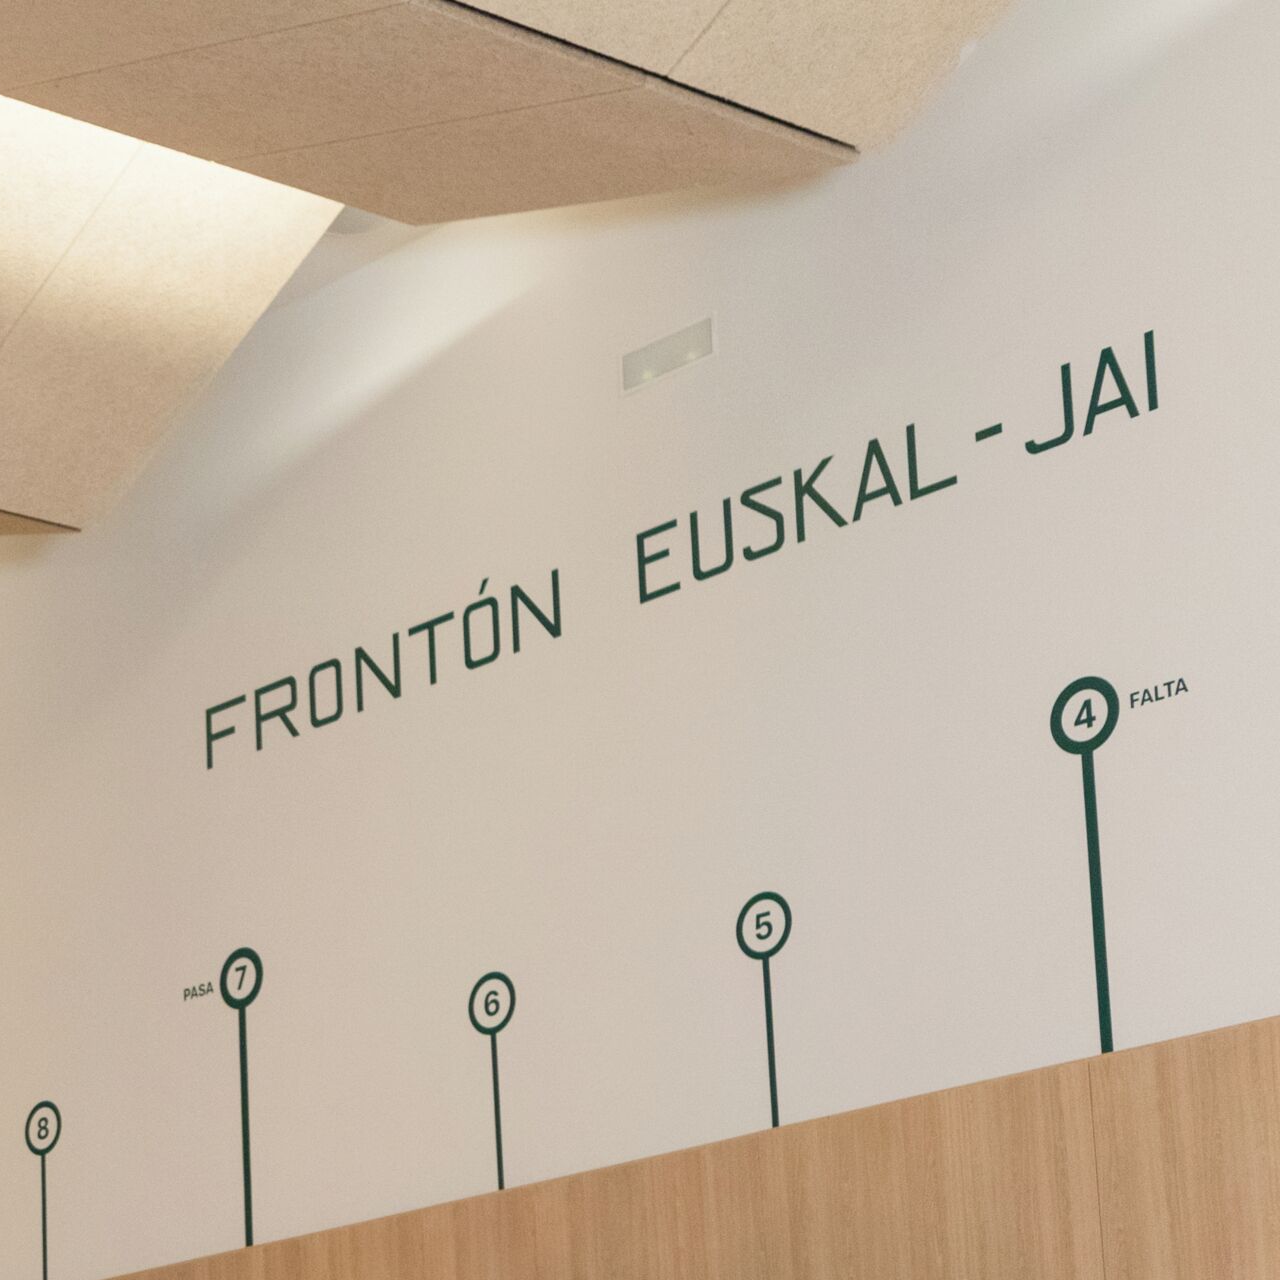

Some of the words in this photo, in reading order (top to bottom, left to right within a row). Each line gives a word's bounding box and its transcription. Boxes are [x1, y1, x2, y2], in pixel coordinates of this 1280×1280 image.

[205, 569, 562, 770] FRONTÓN
[1073, 698, 1097, 729] 4
[1129, 677, 1189, 709] FALTA
[755, 910, 773, 941] 5
[183, 981, 214, 1002] PASA
[235, 964, 247, 991] 7
[484, 990, 500, 1017] 6
[37, 1116, 50, 1140] 8
